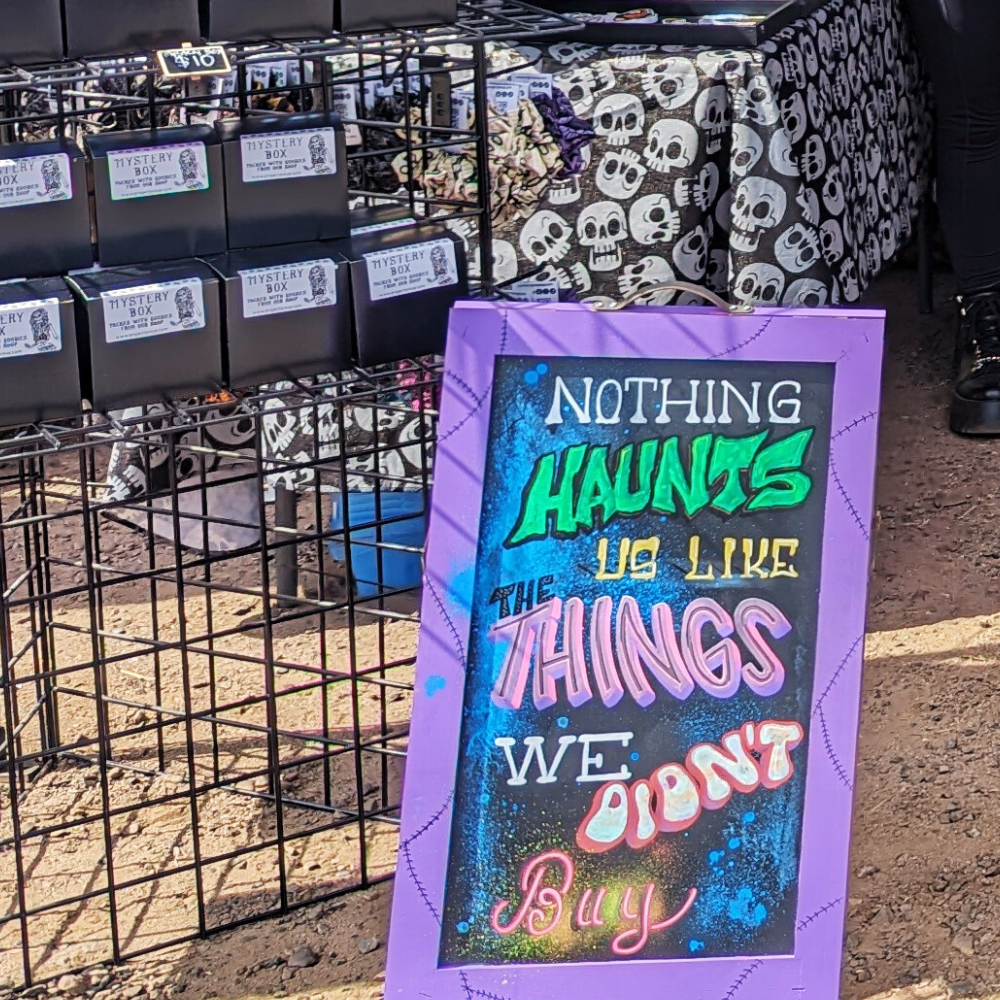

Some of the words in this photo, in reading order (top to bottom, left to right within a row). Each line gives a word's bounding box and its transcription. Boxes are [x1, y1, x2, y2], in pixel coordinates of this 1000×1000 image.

[246, 137, 303, 151] MYSTERY
[113, 152, 174, 168] MYSTERY
[264, 149, 288, 160] BOX
[133, 165, 158, 177] BOX
[0, 174, 19, 186] OX
[371, 250, 425, 270] MYSTERY
[247, 268, 304, 285] MYSTERY
[390, 263, 411, 276] BOX
[265, 281, 288, 294] BOX
[108, 291, 170, 309] MYSTERY
[129, 305, 153, 318] BOX
[543, 376, 803, 426] NOTHING
[505, 427, 815, 547] HAUNTS
[595, 536, 659, 581] US
[686, 536, 800, 580] LIKE
[489, 575, 555, 620] THE
[489, 595, 793, 712] THINGS
[495, 731, 635, 786] WE
[576, 720, 807, 852] DIDN'T
[491, 850, 698, 955] Buy
